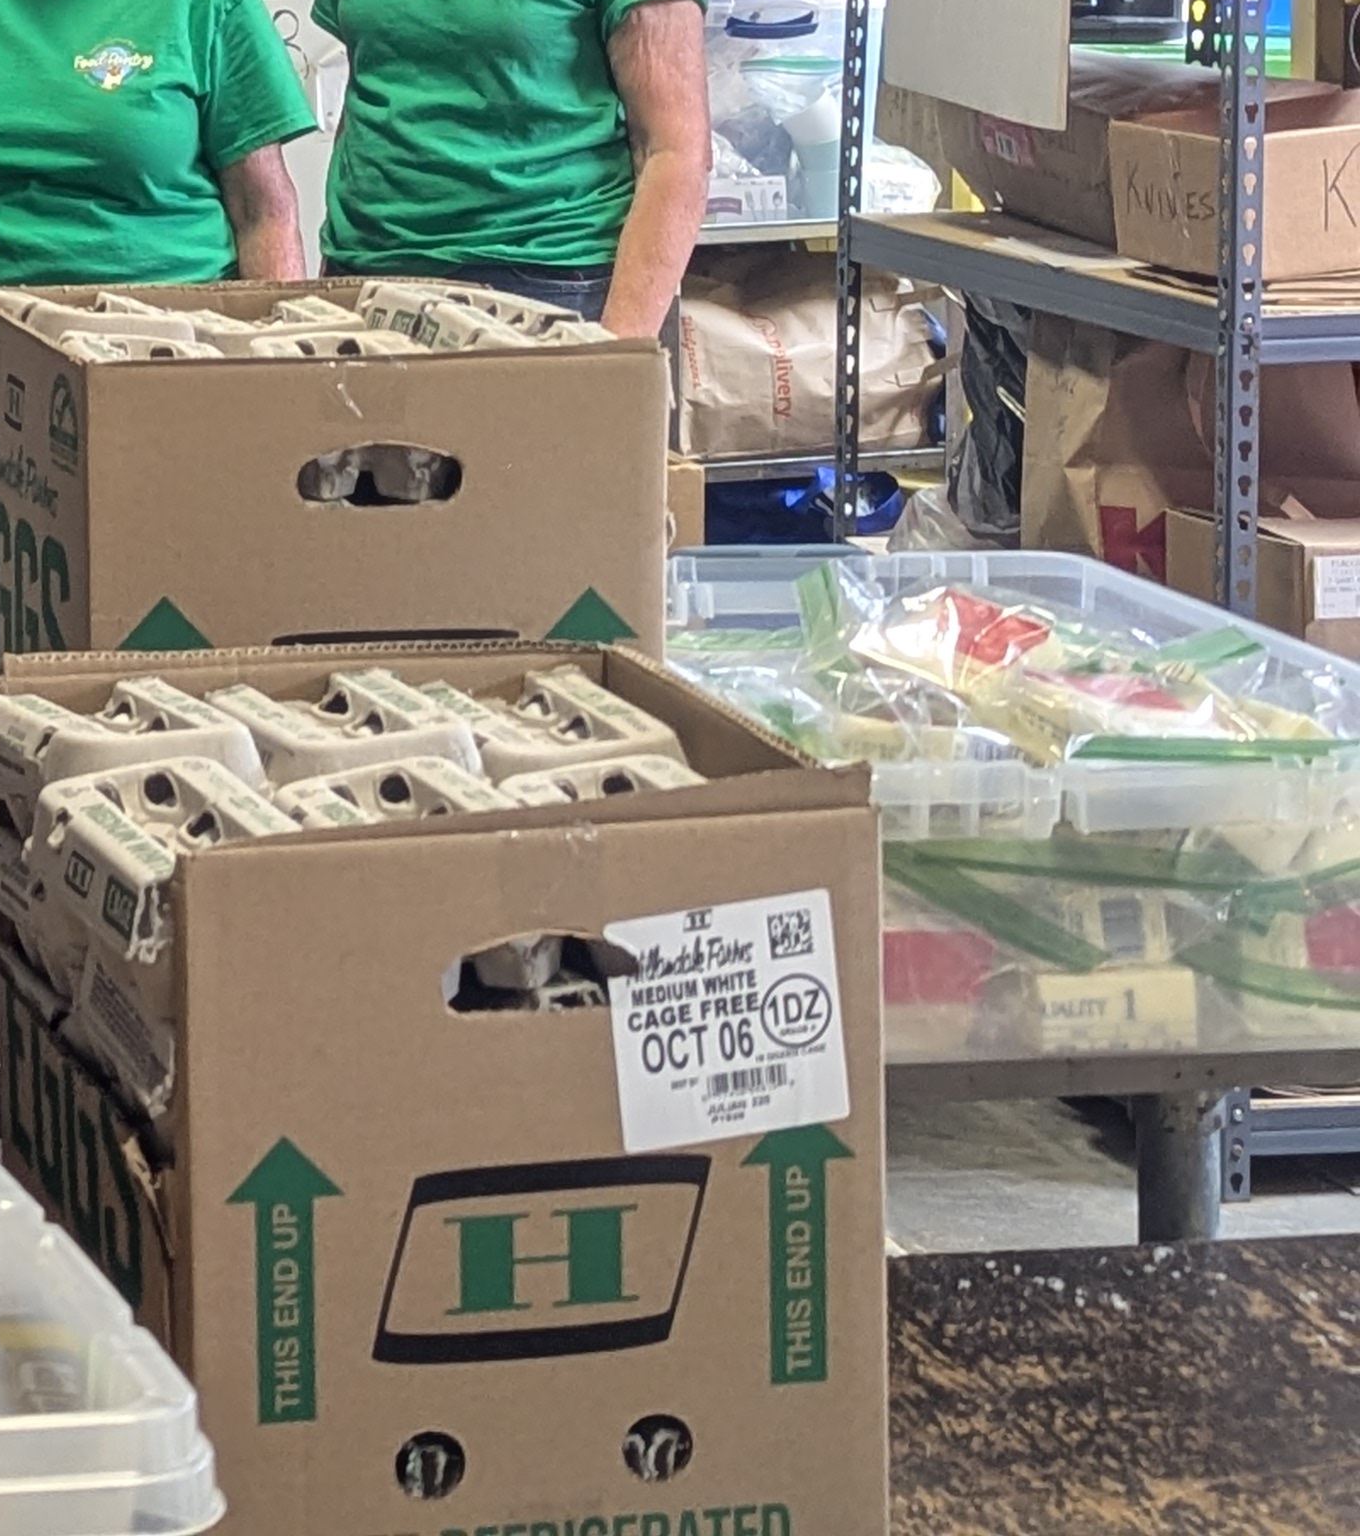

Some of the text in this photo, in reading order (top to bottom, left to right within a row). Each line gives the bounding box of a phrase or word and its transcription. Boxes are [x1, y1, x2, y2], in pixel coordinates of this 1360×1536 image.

[1125, 159, 1215, 221] KNIVES
[626, 935, 705, 986] illandale
[627, 992, 761, 1033] CAGE FREE
[631, 968, 758, 1008] MEDIUM WHITE
[767, 988, 823, 1028] 1DZ
[1043, 997, 1107, 1018] UALITY
[641, 1024, 710, 1074] OCT
[718, 1017, 755, 1062] 06
[443, 1203, 639, 1317] H
[786, 1165, 816, 1375] THIS END UP
[272, 1203, 301, 1411] THIS END UP
